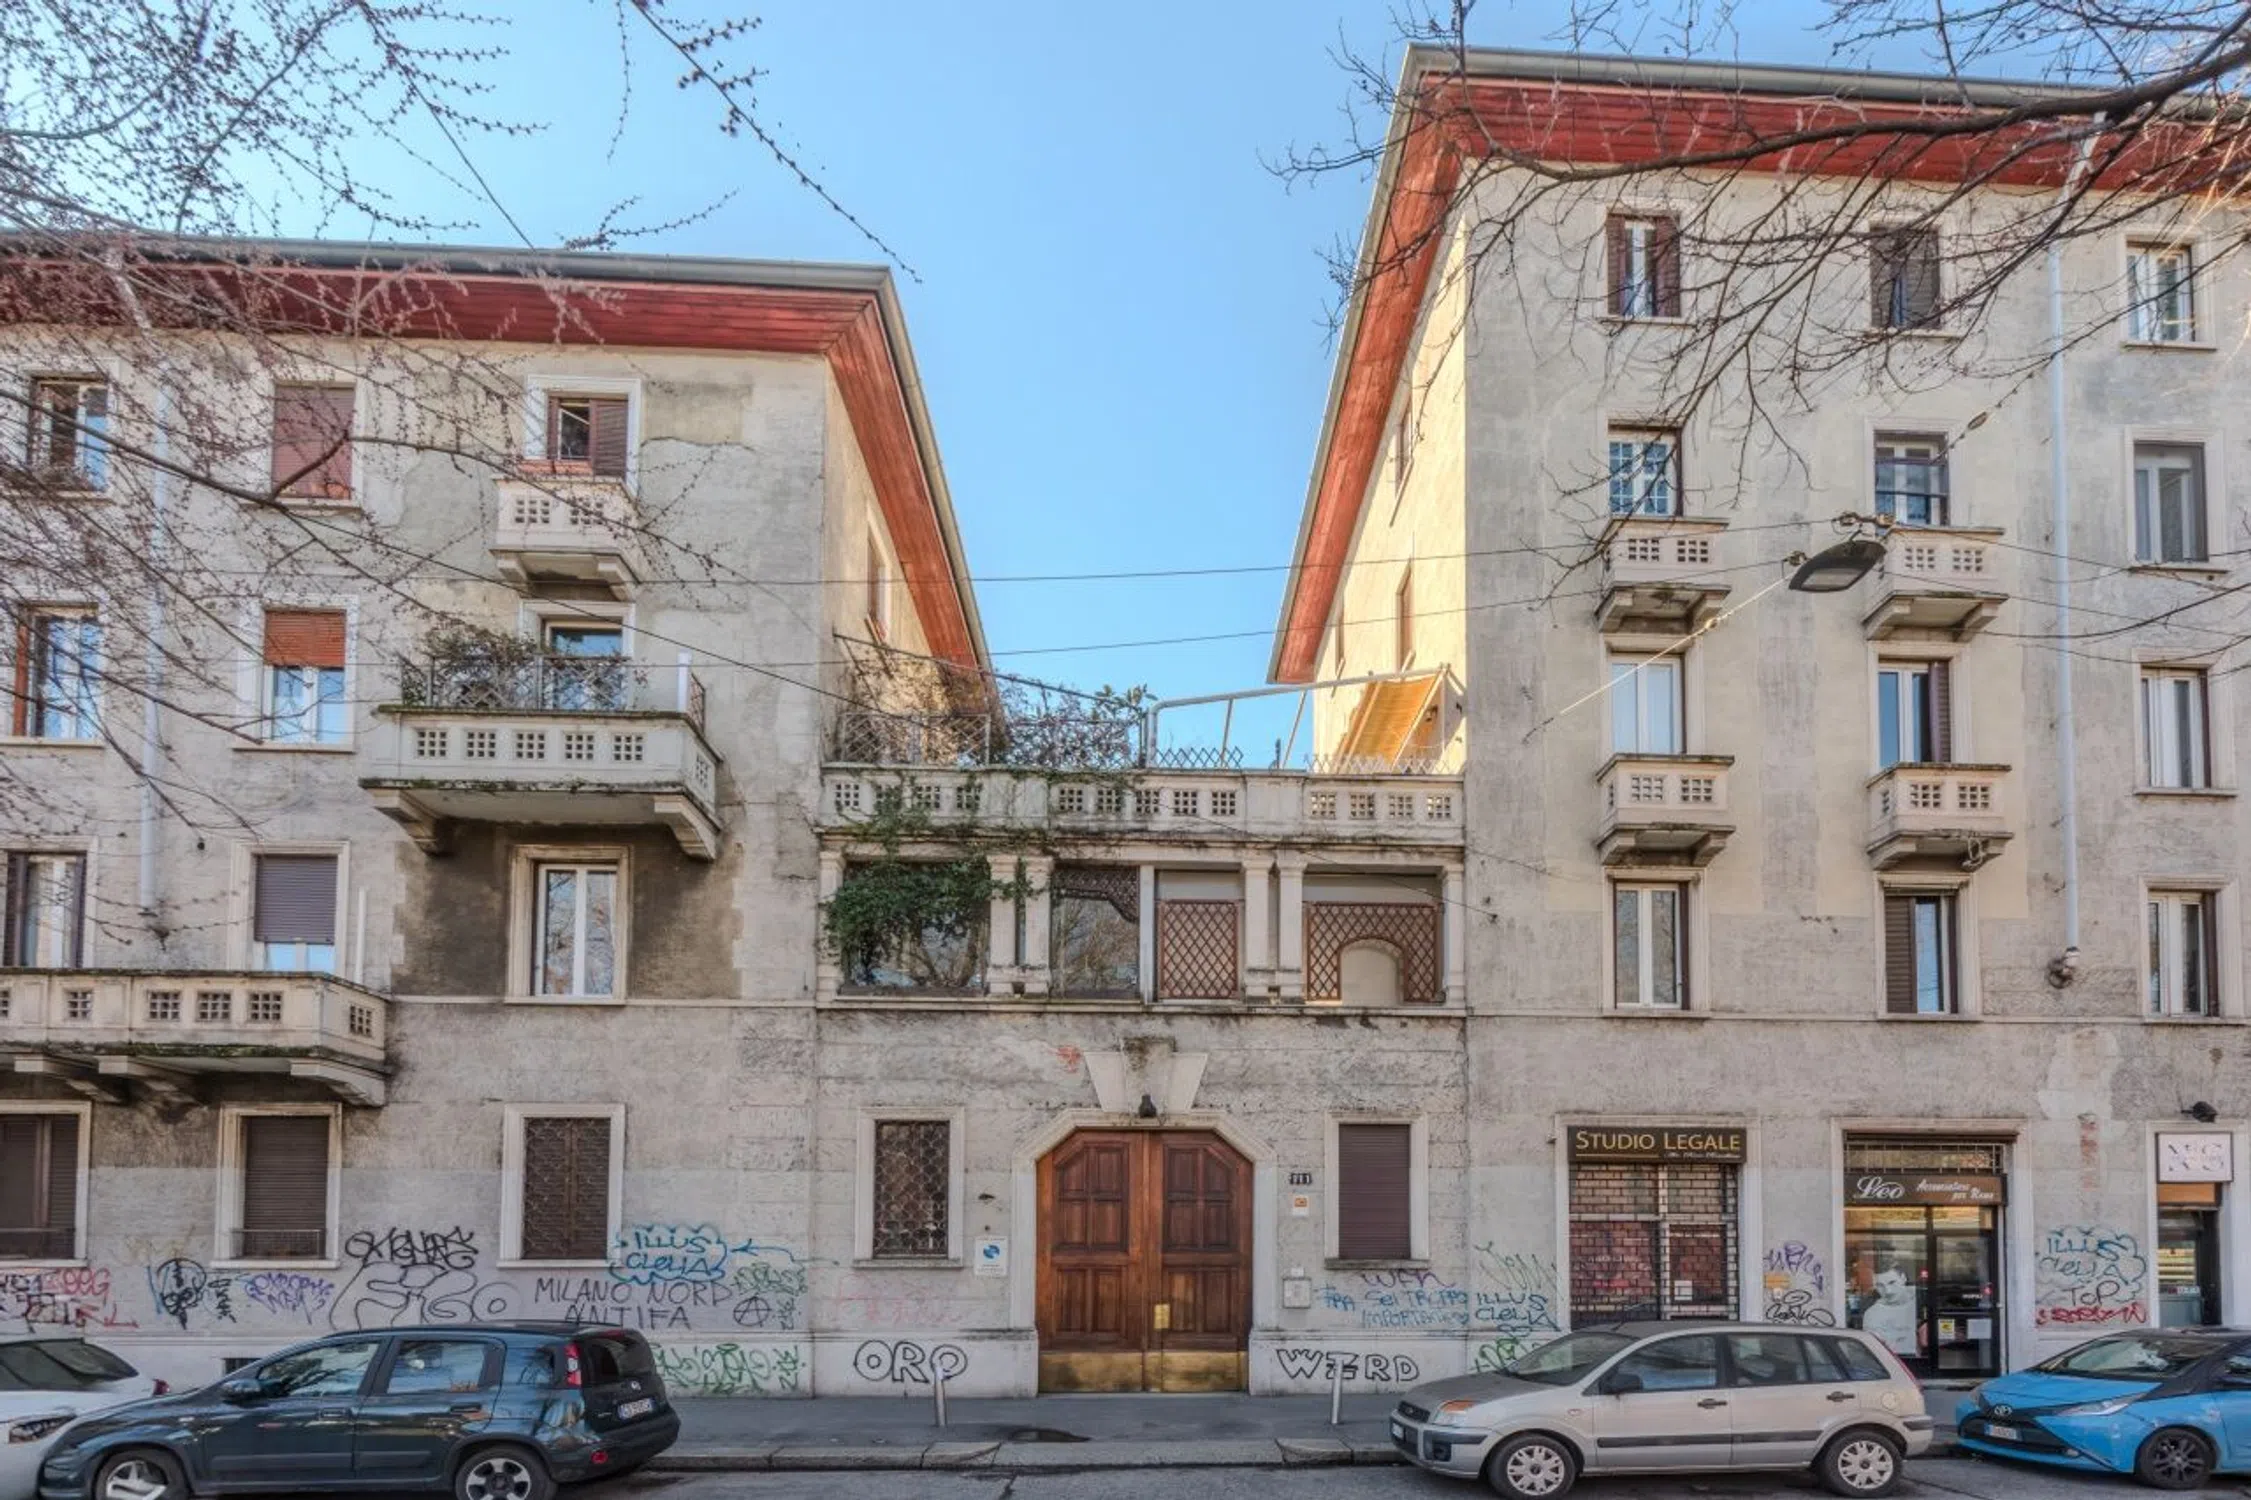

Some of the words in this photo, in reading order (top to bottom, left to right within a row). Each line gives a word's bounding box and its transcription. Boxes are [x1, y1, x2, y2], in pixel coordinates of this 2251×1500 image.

[1575, 1130, 1656, 1150] STUDIO
[1663, 1132, 1742, 1151] LEGALE
[534, 1276, 632, 1303] MILANO
[649, 1279, 734, 1307] NORD
[563, 1303, 691, 1330] ANTIFA
